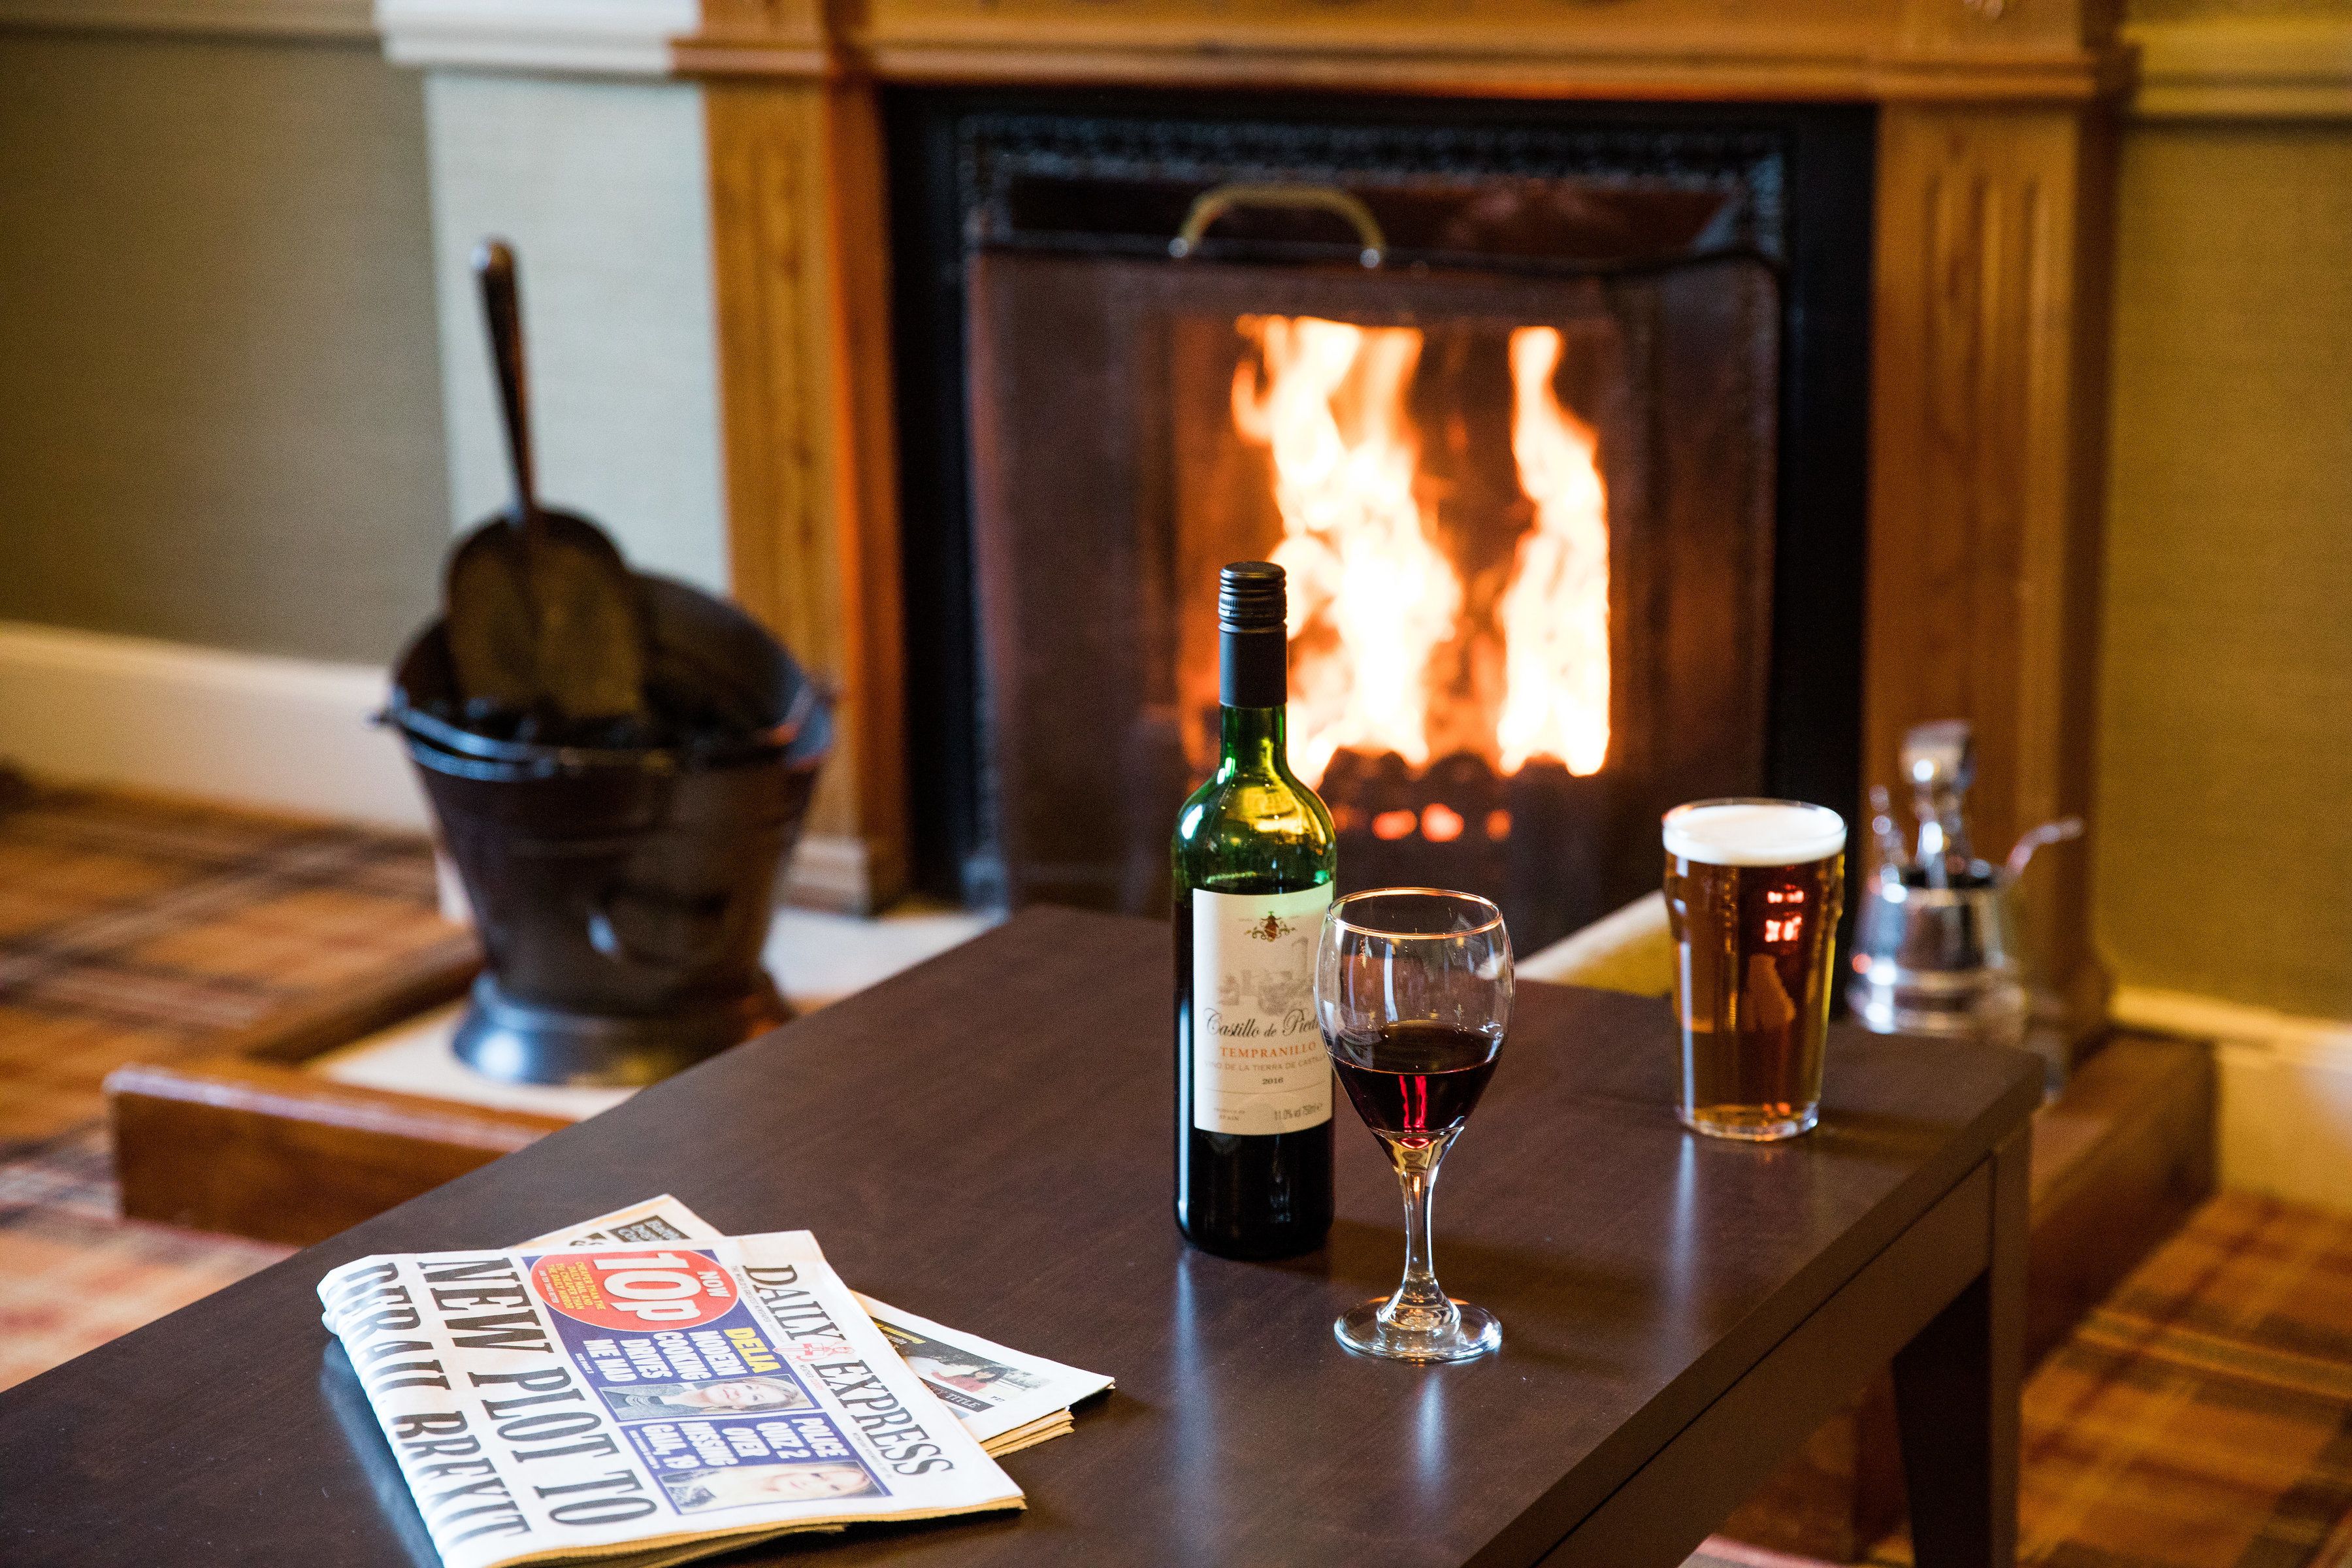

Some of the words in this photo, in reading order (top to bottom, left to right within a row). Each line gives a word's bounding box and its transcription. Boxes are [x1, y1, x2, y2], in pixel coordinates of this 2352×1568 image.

[1204, 1007, 1260, 1037] Castillo
[1264, 1023, 1277, 1037] de
[1221, 1041, 1316, 1058] TEMPRANILLO
[1252, 1063, 1282, 1071] TIERRA
[1285, 1061, 1296, 1070] DE
[546, 1264, 557, 1273] THE
[550, 1275, 565, 1289] DAILY
[566, 1266, 581, 1280] DAILY
[557, 1290, 574, 1308] MIRROR
[560, 1271, 578, 1294] CHEAPER
[571, 1296, 585, 1309] THAN
[574, 1262, 594, 1283] CHEAPER
[586, 1284, 600, 1299] THAN
[593, 1300, 606, 1310] THE
[574, 1281, 587, 1294] MAIL
[593, 1252, 701, 1321] 10p
[697, 1271, 731, 1298] NOW
[417, 1258, 554, 1354] NEW
[580, 1295, 593, 1305] AND
[583, 1339, 621, 1359] ME
[620, 1339, 673, 1379] DRIVES
[653, 1331, 712, 1380] COOKING
[689, 1330, 748, 1375] MODERN
[724, 1327, 783, 1373] DELIA
[594, 1358, 637, 1382] MAD
[742, 1265, 846, 1341] DAILY
[810, 1360, 955, 1475] EXPRESS
[468, 1366, 621, 1463] PLOT
[945, 1393, 981, 1408] TITLE
[678, 1422, 738, 1466] MISSING
[722, 1427, 771, 1458] OVER
[756, 1422, 804, 1450] QUIZ
[792, 1418, 849, 1457] POLICE
[663, 1454, 700, 1469] 19
[776, 1449, 811, 1459] 2
[532, 1468, 657, 1526] TO
